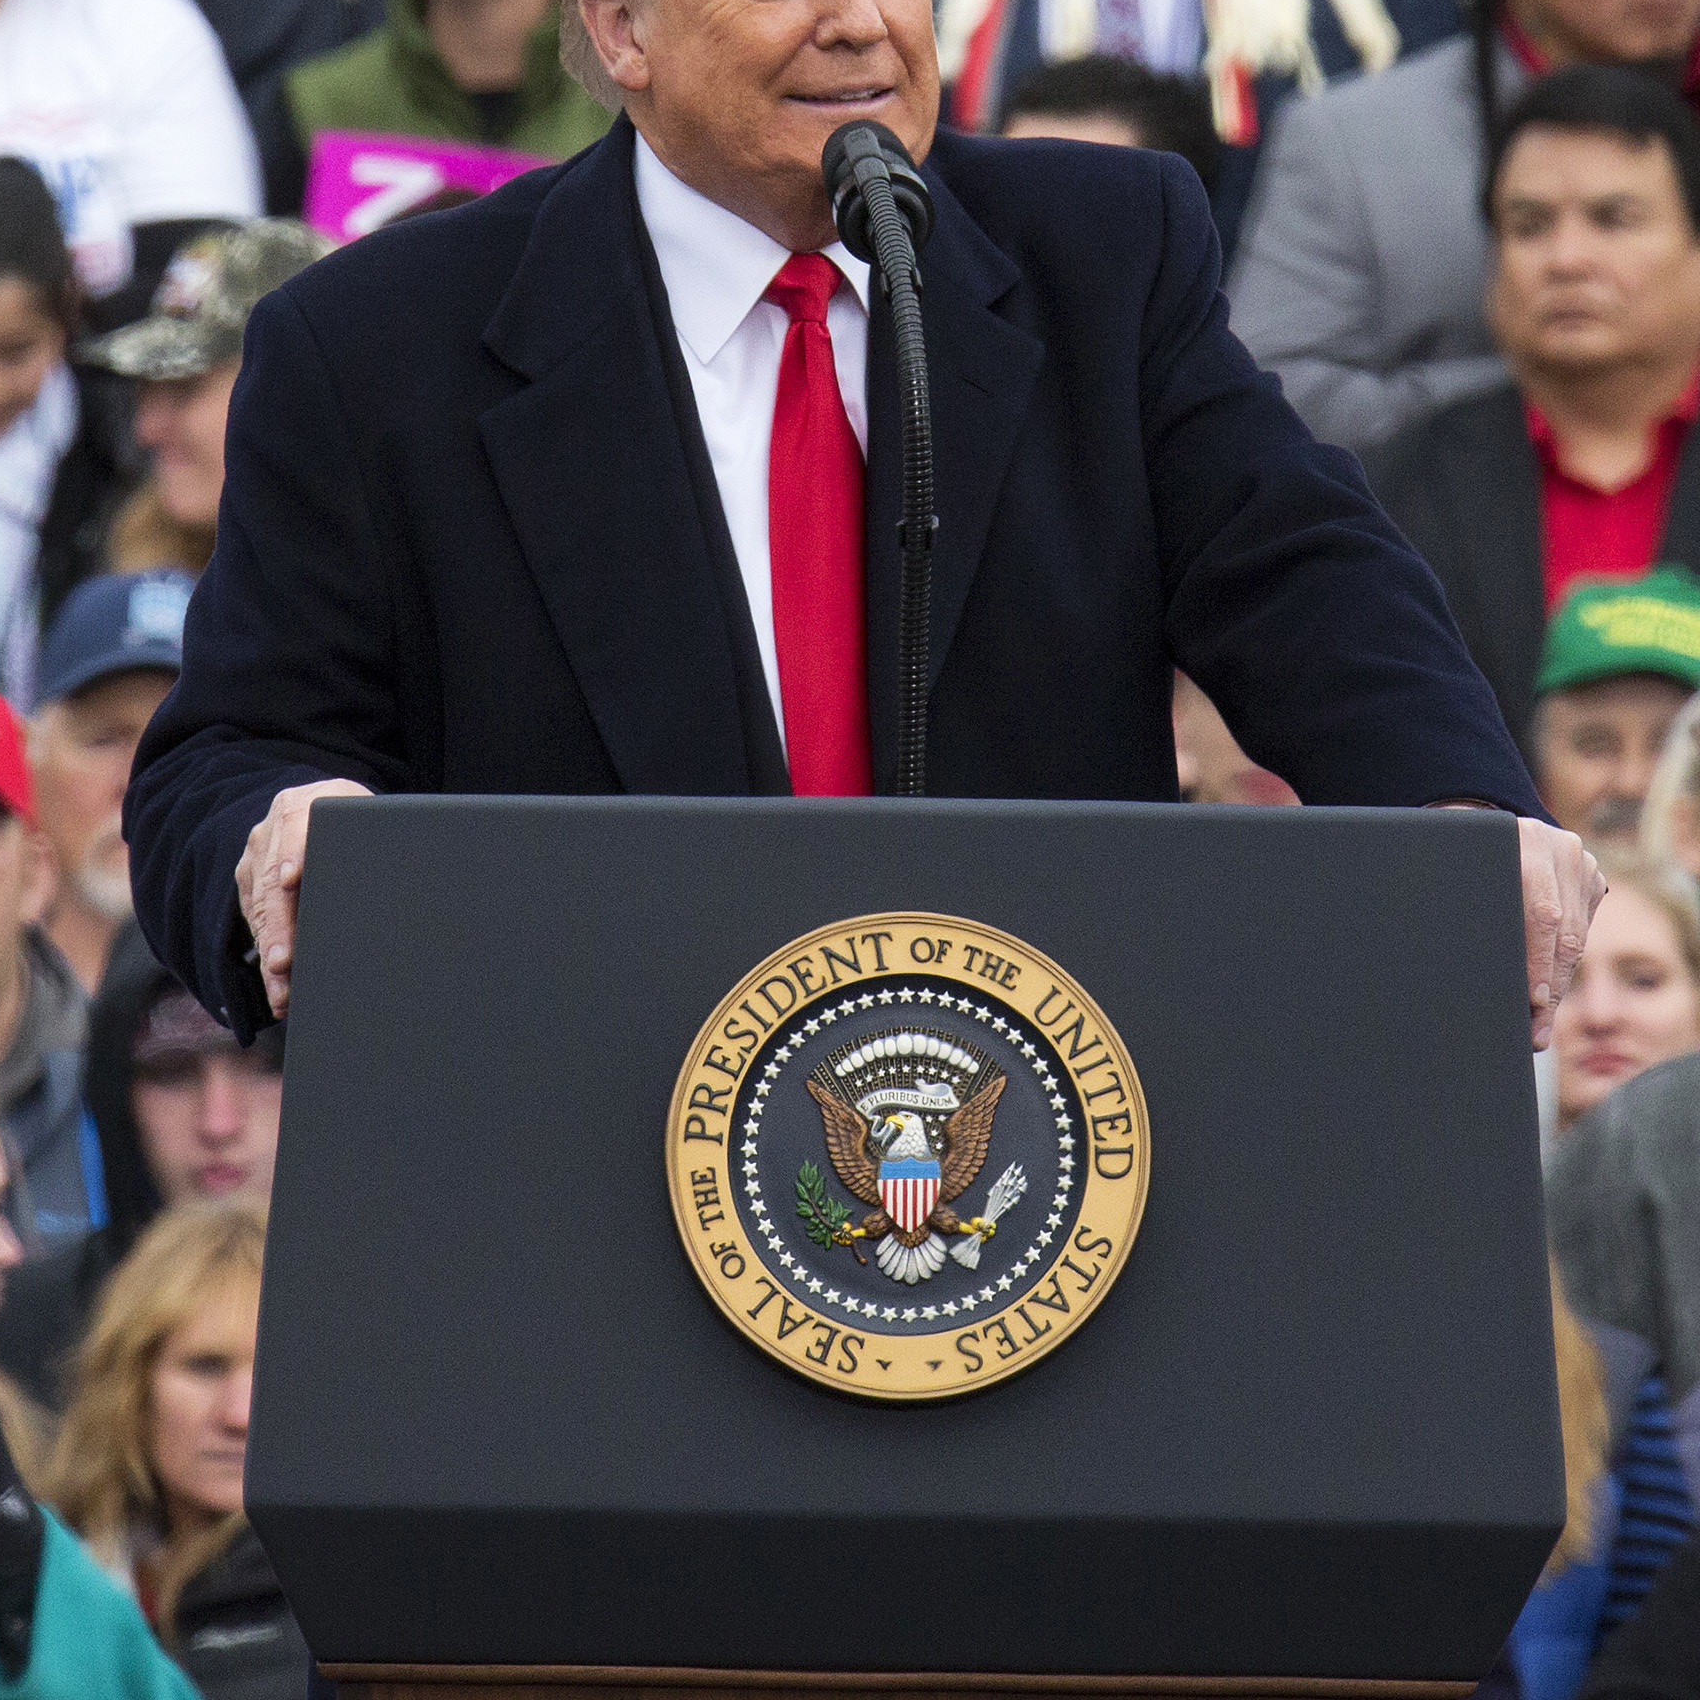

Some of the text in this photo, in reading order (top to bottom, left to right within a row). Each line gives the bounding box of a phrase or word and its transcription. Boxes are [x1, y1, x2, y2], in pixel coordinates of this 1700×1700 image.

[684, 931, 1135, 1375] SEAL OF THE PRESIDENT OF THE UNITED STATES
[867, 1091, 919, 1109] PLURIBUS
[920, 1092, 953, 1107] UNUM
